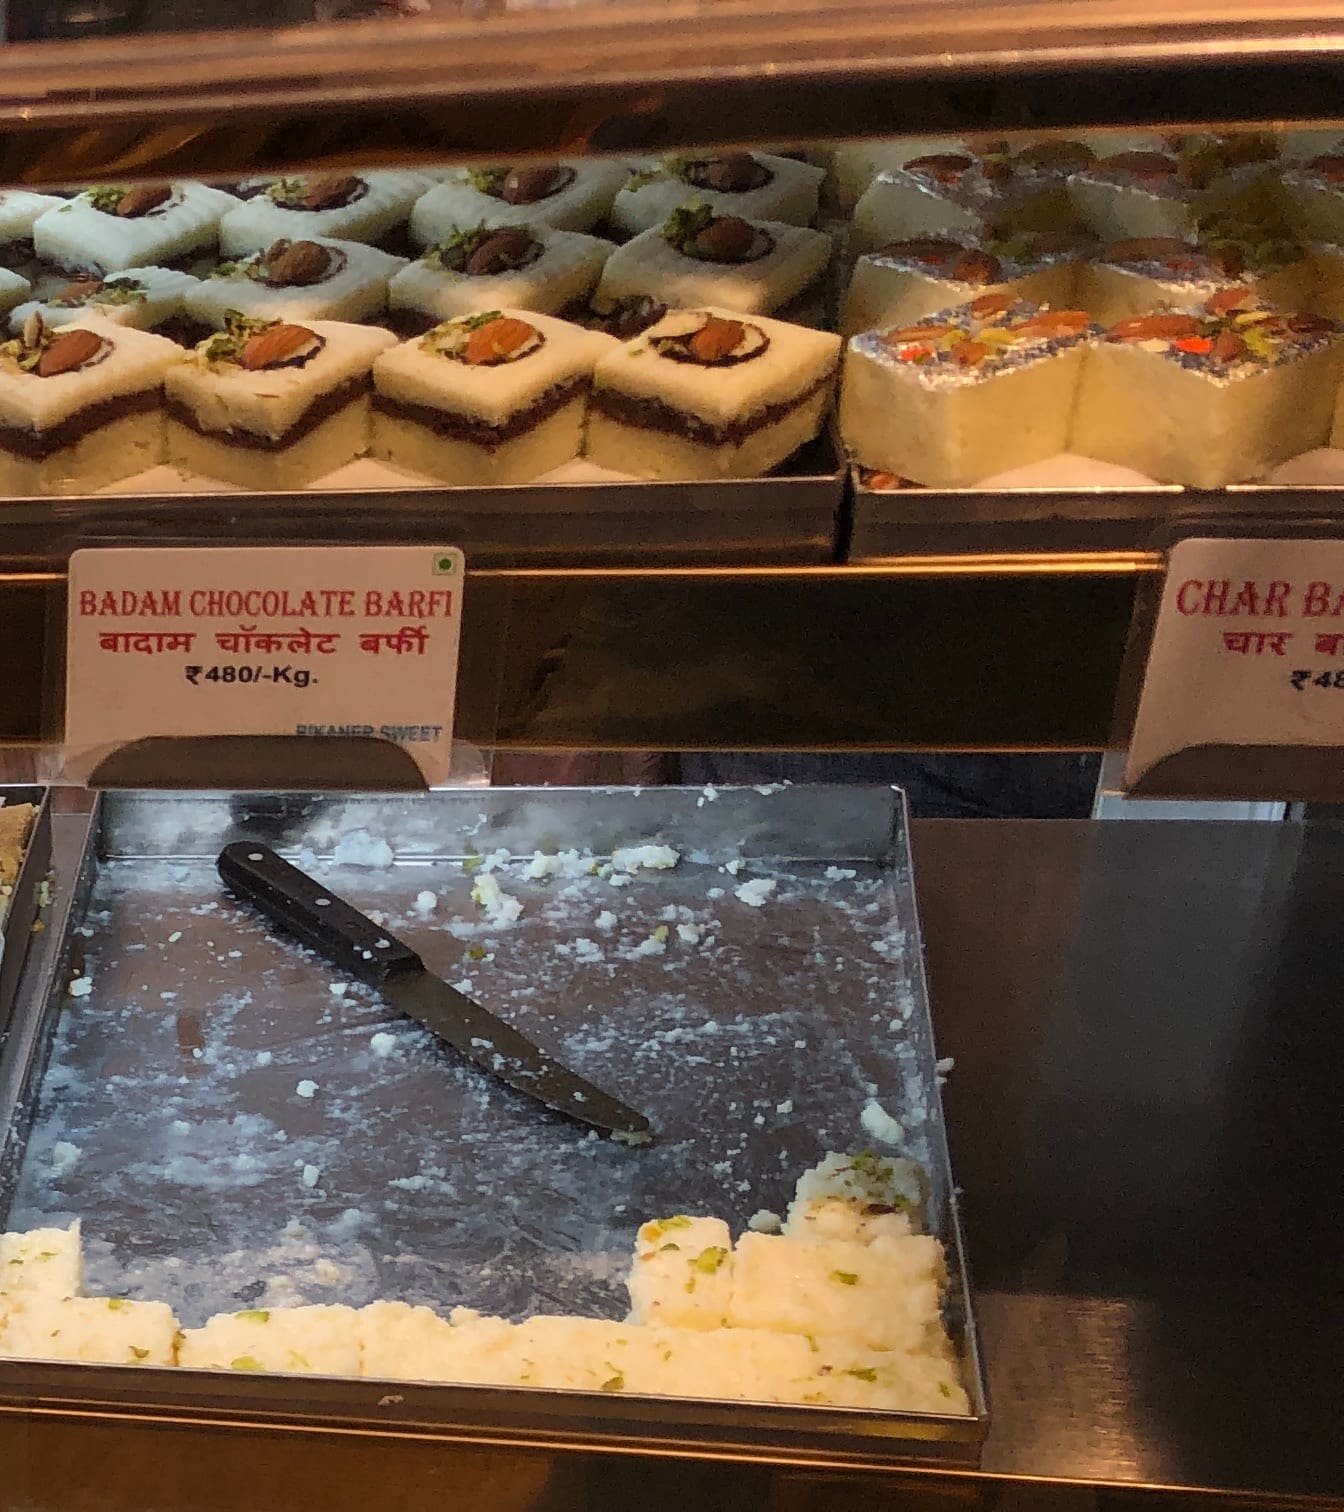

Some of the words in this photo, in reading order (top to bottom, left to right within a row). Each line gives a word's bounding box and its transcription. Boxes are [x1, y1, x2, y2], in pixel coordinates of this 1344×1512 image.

[80, 590, 181, 616] BADAM
[190, 590, 356, 617] CHOCOLATE
[364, 590, 453, 618] BARFI
[1176, 579, 1292, 617] CHAR
[99, 632, 196, 654] बादाम
[215, 625, 340, 655] चॉकलेट
[359, 625, 430, 655] बर्फी
[1223, 631, 1294, 655] चार
[185, 665, 319, 688] ₹480/-Kg.
